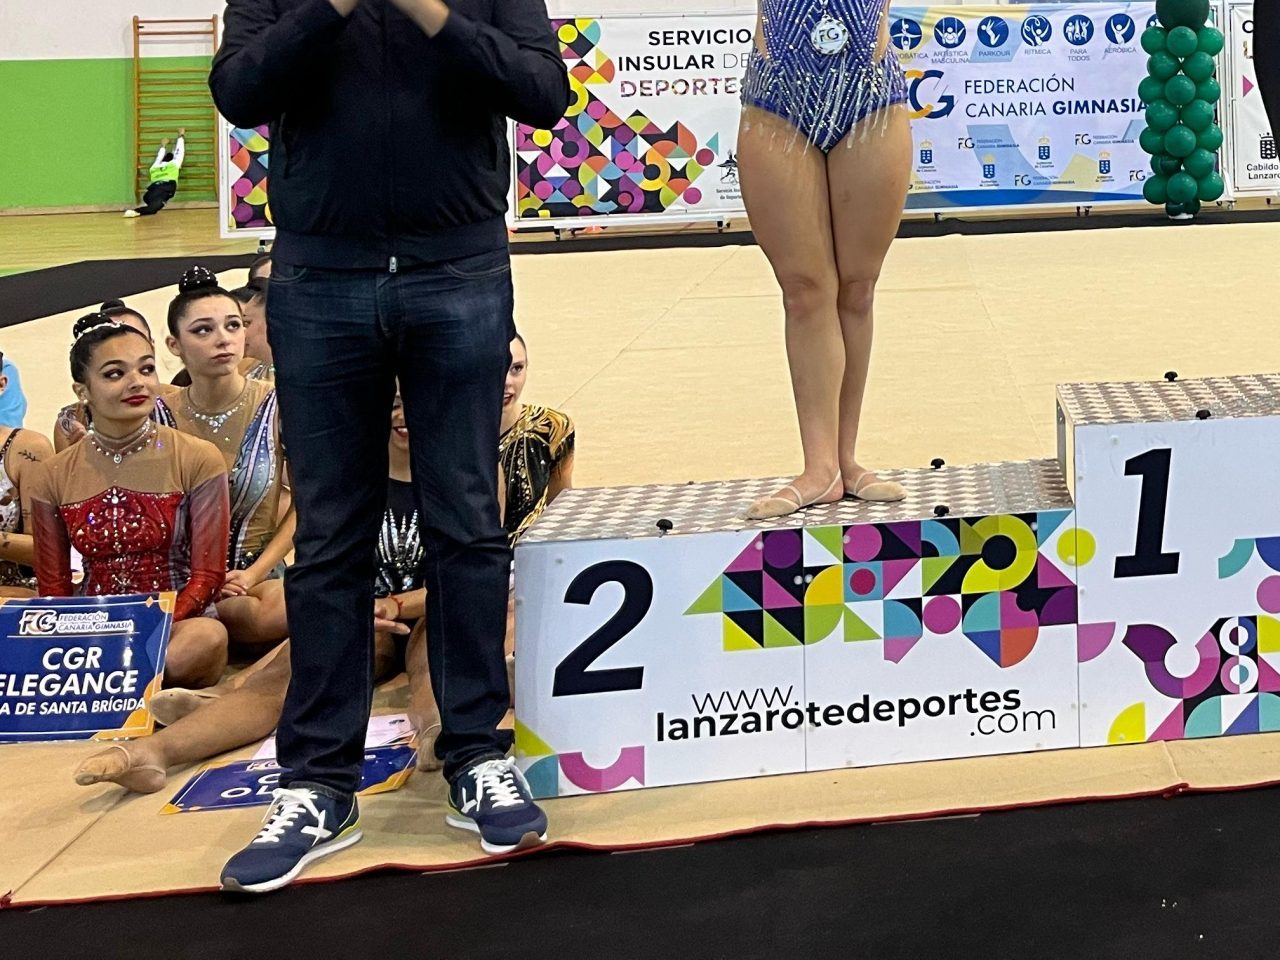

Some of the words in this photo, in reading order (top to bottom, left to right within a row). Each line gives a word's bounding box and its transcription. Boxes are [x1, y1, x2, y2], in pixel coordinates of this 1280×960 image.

[648, 28, 752, 46] SERVICIO
[617, 54, 715, 72] INSULAR
[964, 73, 1075, 94] FEDERACIÓN
[965, 101, 1047, 118] CANARIA
[1052, 98, 1149, 116] GIMNASIA
[1246, 163, 1279, 171] Cabildo
[1113, 447, 1182, 579] 1
[551, 559, 655, 699] 2
[42, 646, 103, 671] CGR
[0, 670, 139, 697] ELEGANCE
[14, 702, 36, 715] DE
[39, 701, 89, 715] SANTA
[91, 695, 146, 714] BRÍGIDA
[690, 685, 801, 715] www.
[656, 687, 1022, 743] lanzarotedeportes
[969, 705, 1057, 738] .com
